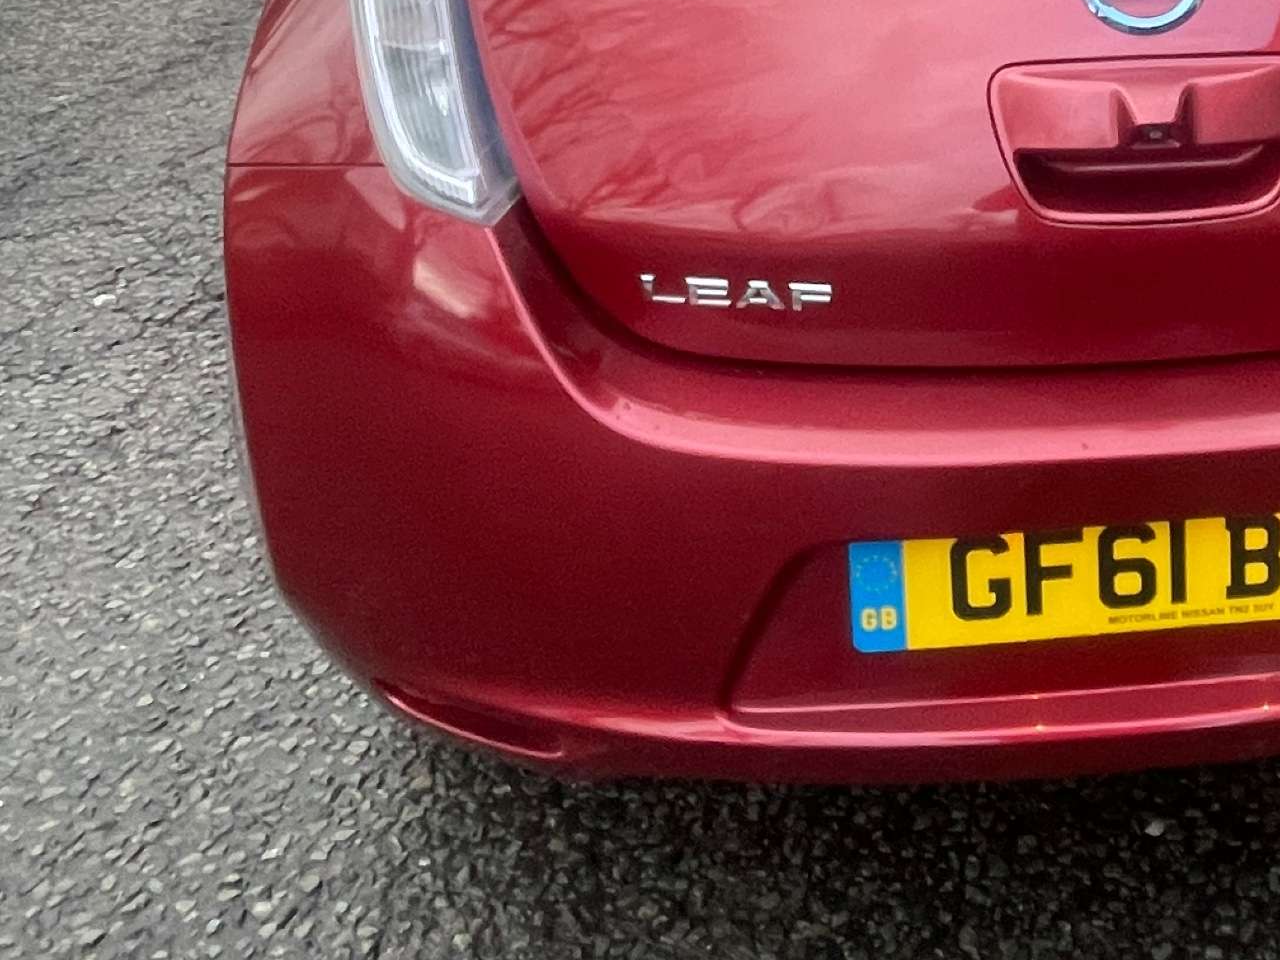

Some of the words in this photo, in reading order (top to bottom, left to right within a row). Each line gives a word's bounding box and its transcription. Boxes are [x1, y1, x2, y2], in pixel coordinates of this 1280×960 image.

[640, 274, 832, 311] LEAF
[860, 606, 898, 632] GB
[950, 519, 1188, 621] GF61
